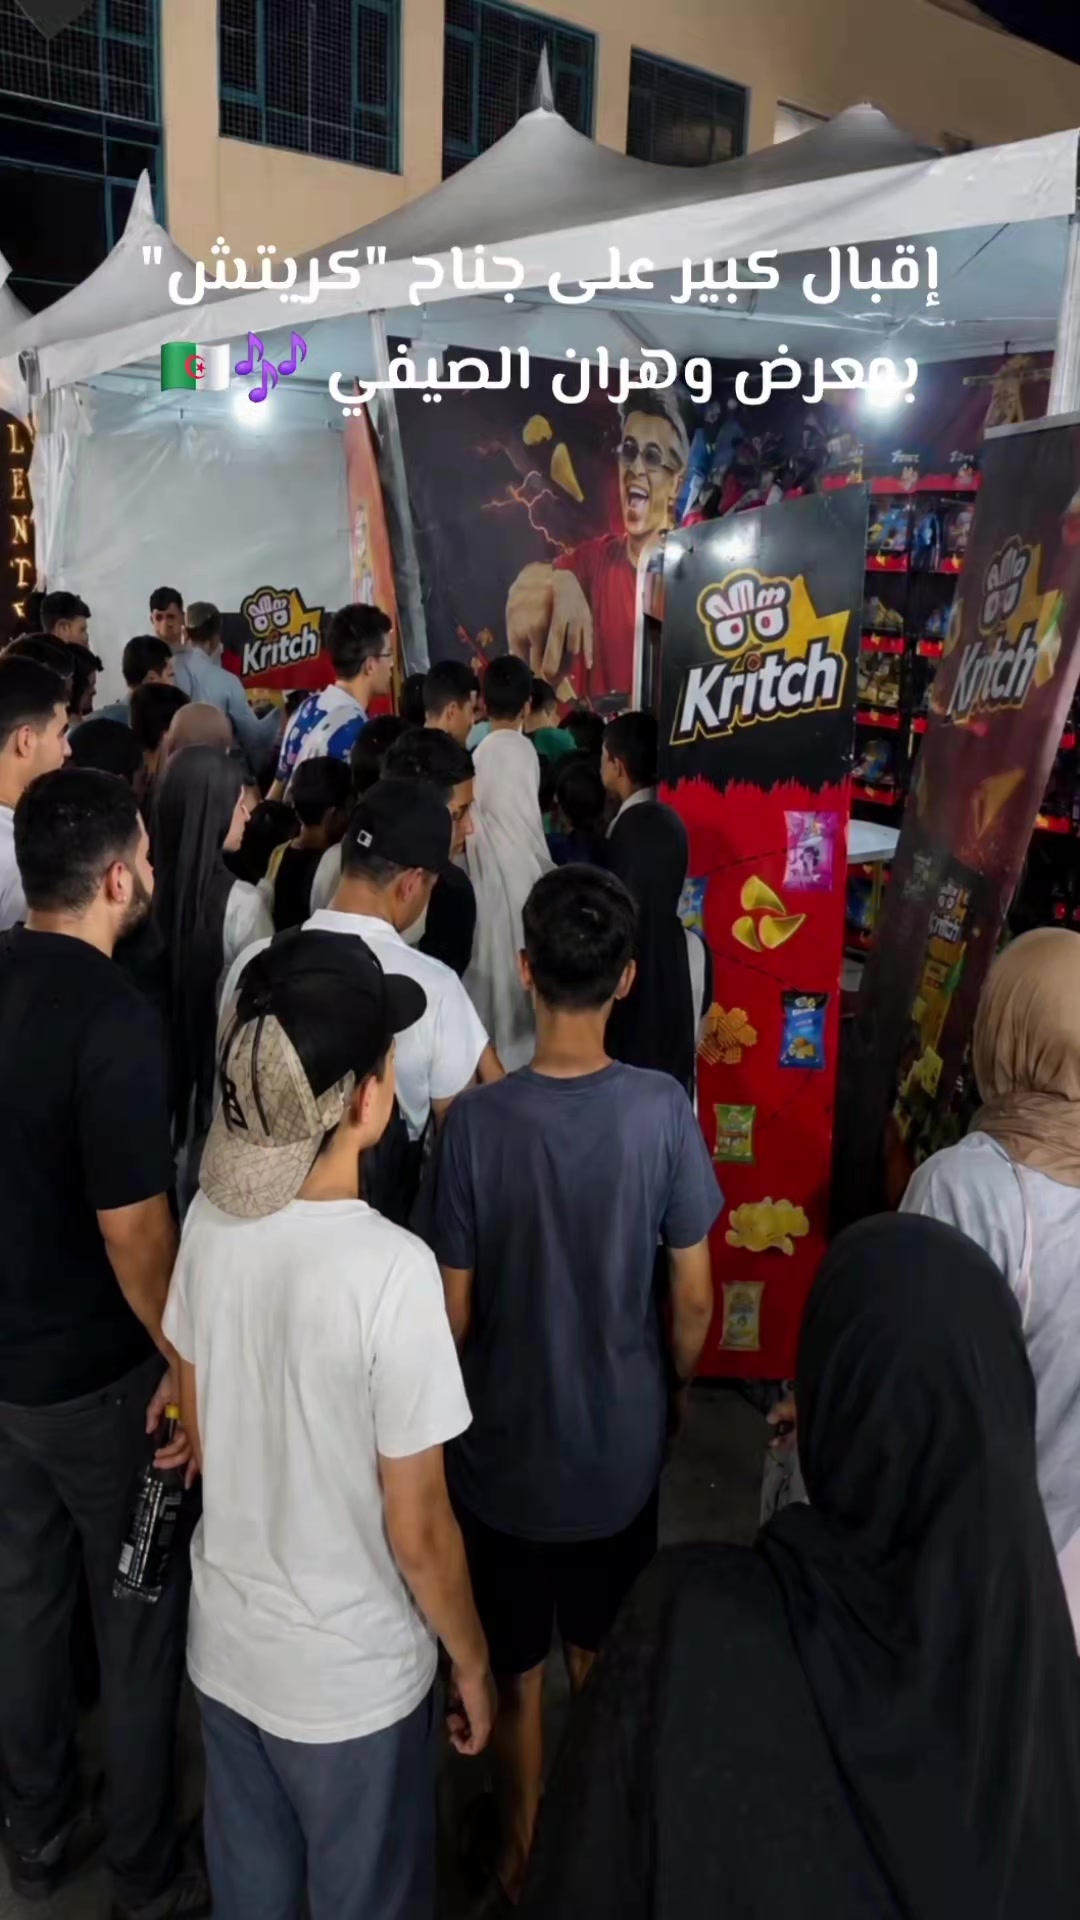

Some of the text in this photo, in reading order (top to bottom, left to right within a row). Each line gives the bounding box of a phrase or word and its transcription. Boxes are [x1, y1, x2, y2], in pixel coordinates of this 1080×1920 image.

[242, 625, 317, 675] Kritch
[679, 641, 838, 733] Kritch
[946, 627, 1037, 716] Kritch
